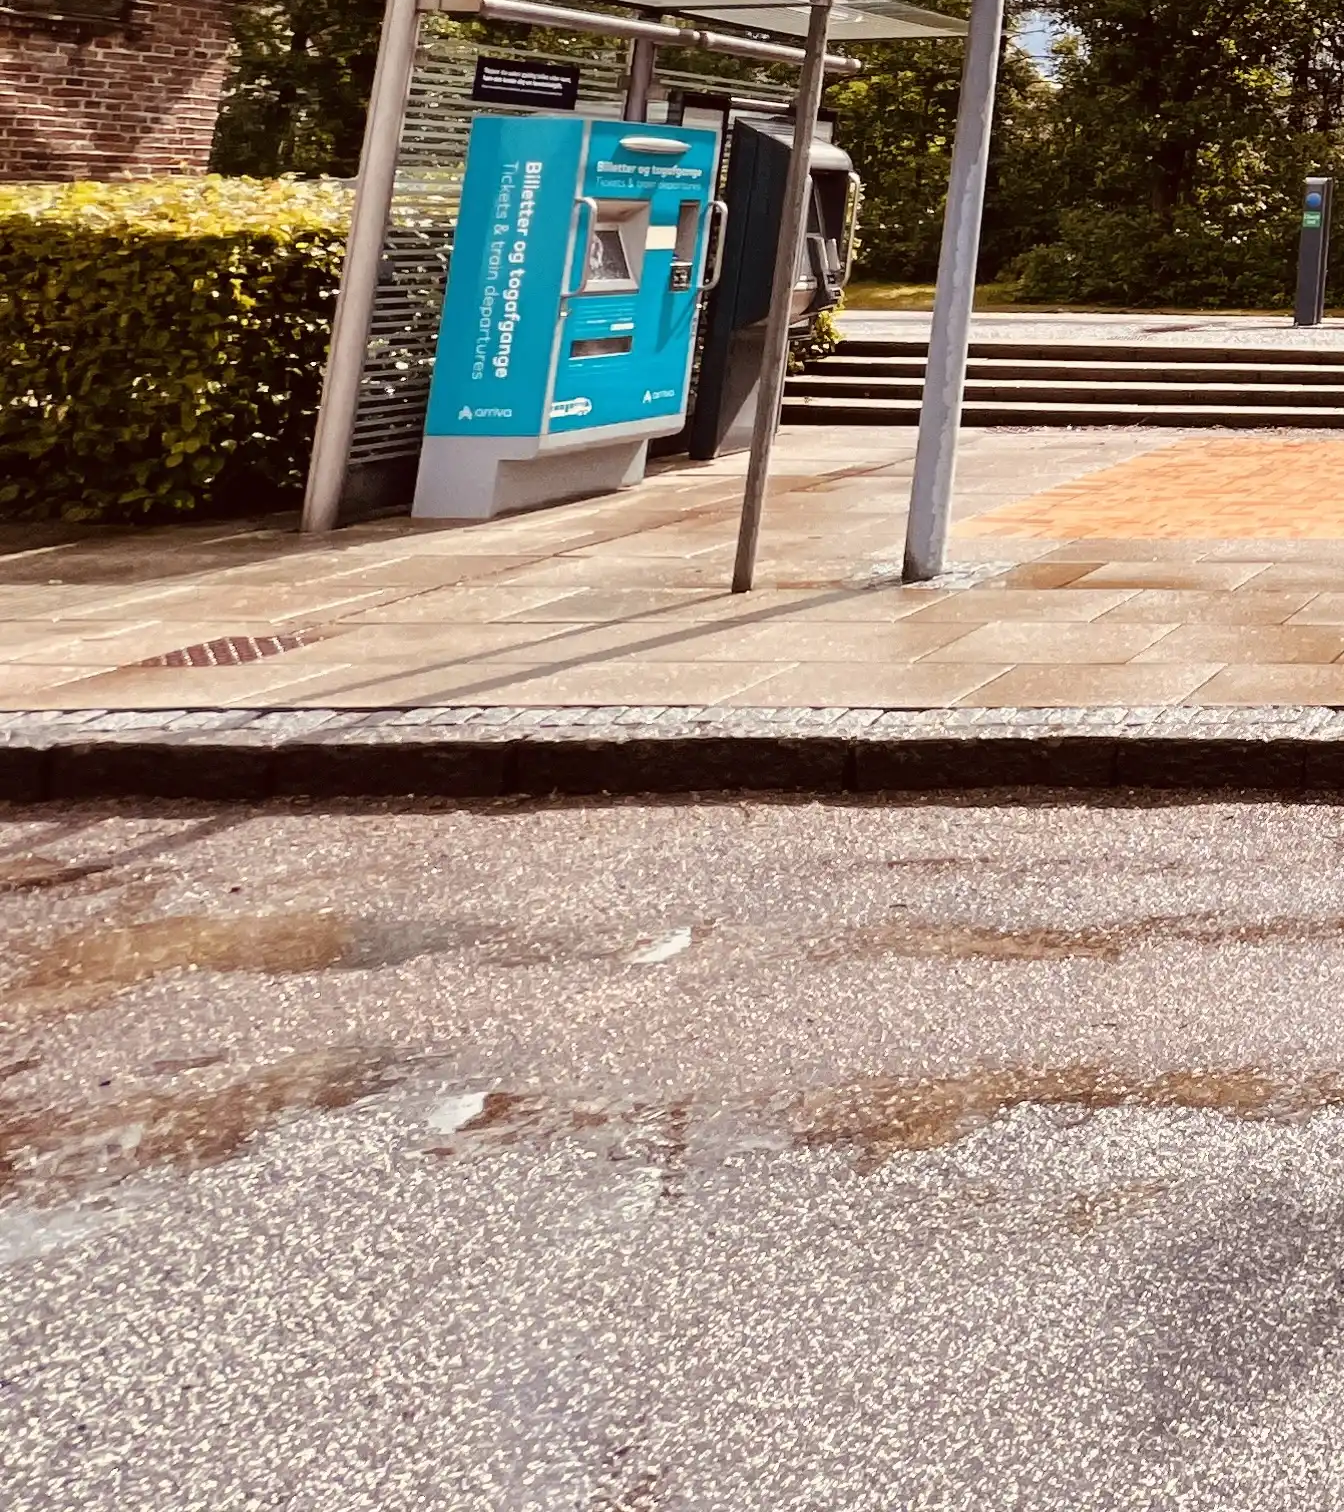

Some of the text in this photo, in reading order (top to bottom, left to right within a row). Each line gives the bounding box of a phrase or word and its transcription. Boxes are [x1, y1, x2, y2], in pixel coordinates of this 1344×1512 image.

[472, 161, 519, 380] Tickets & train departures
[492, 161, 543, 378] Billetter og togafgange
[474, 408, 512, 418] arriva
